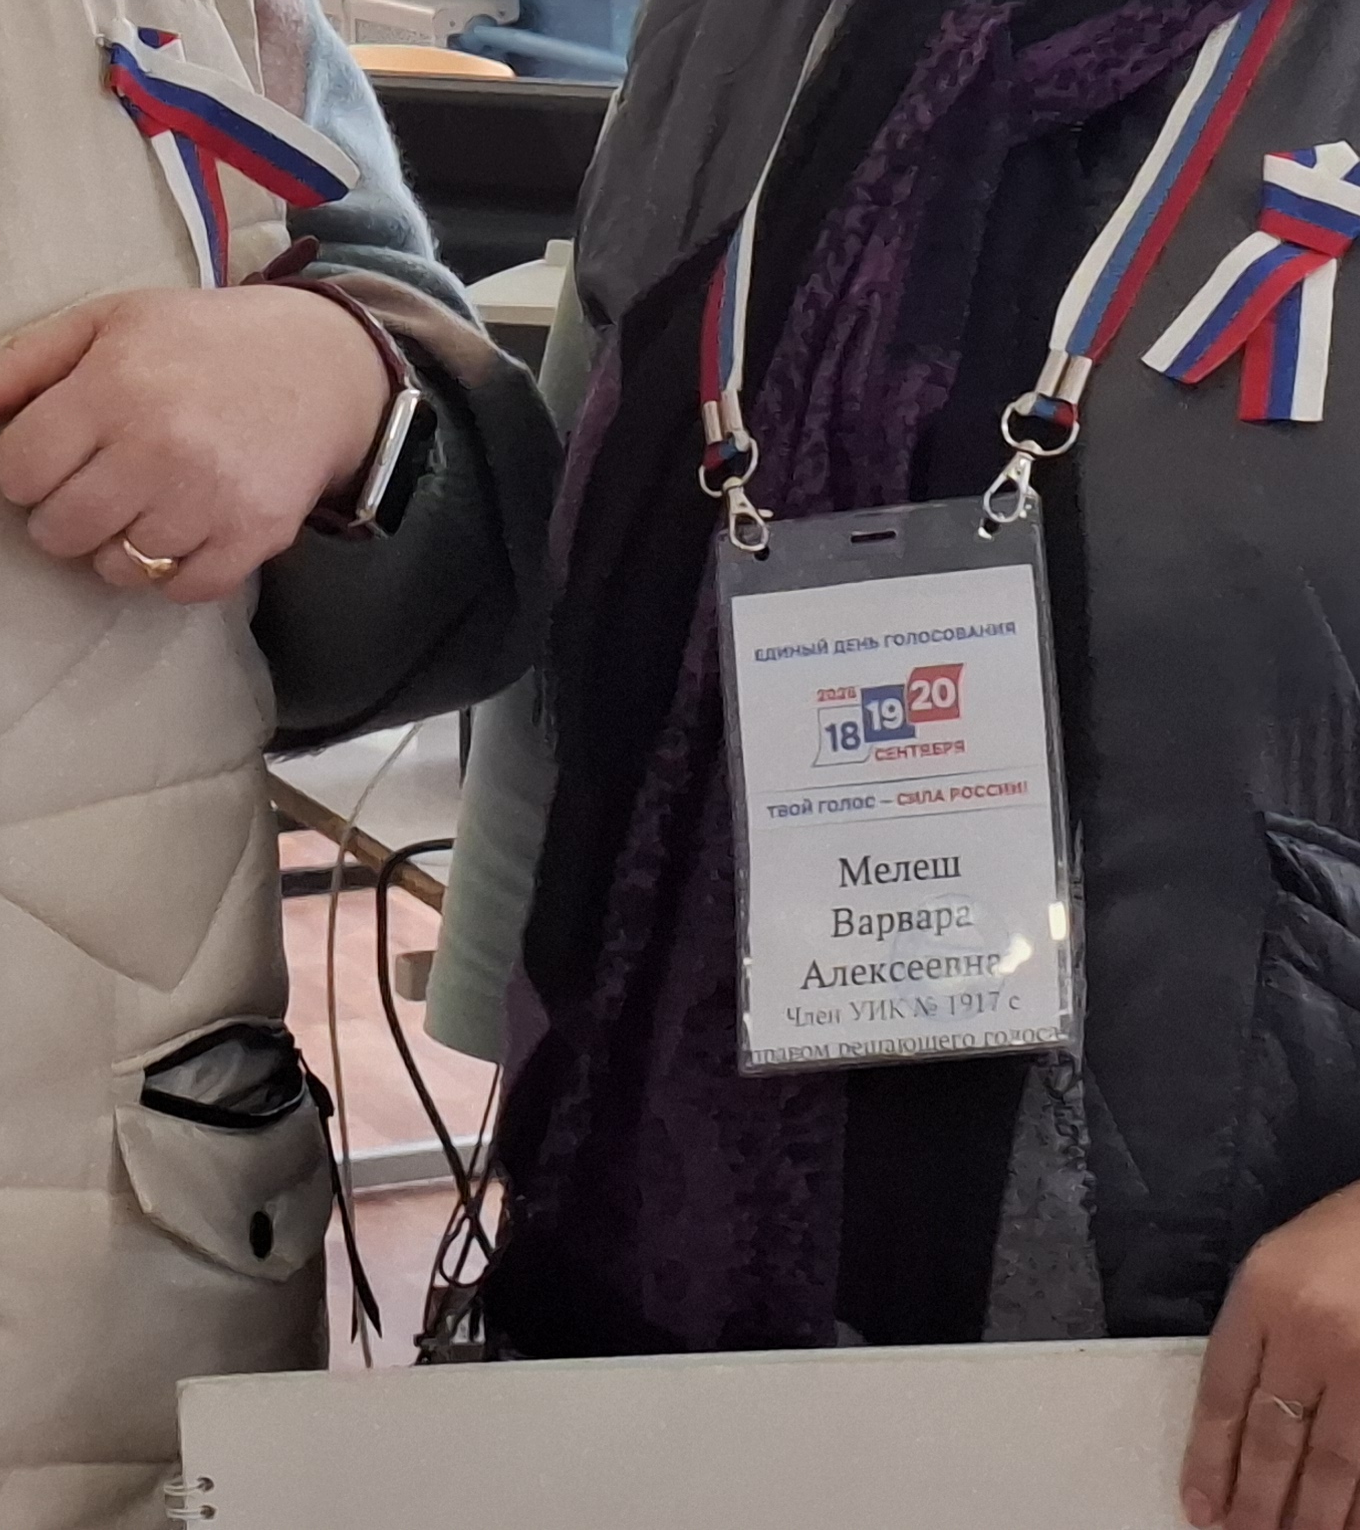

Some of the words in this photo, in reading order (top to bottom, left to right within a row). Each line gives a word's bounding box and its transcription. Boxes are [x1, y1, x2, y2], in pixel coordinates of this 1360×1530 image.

[754, 638, 828, 662] ЕДИНЫЙ
[833, 637, 879, 654] ДЕНЬ
[884, 621, 1016, 648] ГОЛОСОВАНИЯ
[825, 721, 860, 752] 18
[865, 698, 904, 731] 19
[909, 679, 955, 711] 20
[875, 740, 965, 761] СЕНТЯБРЯ
[767, 799, 812, 818] ТВОЙ
[818, 796, 875, 814] ГОЛОС
[897, 790, 944, 806] СИЛА
[950, 781, 1028, 802] РОССИИ!
[838, 855, 962, 888] Мелеш
[831, 905, 974, 941] Варвара
[787, 1007, 841, 1027] Член
[849, 1001, 904, 1022] УИК
[949, 990, 1000, 1016] 1917
